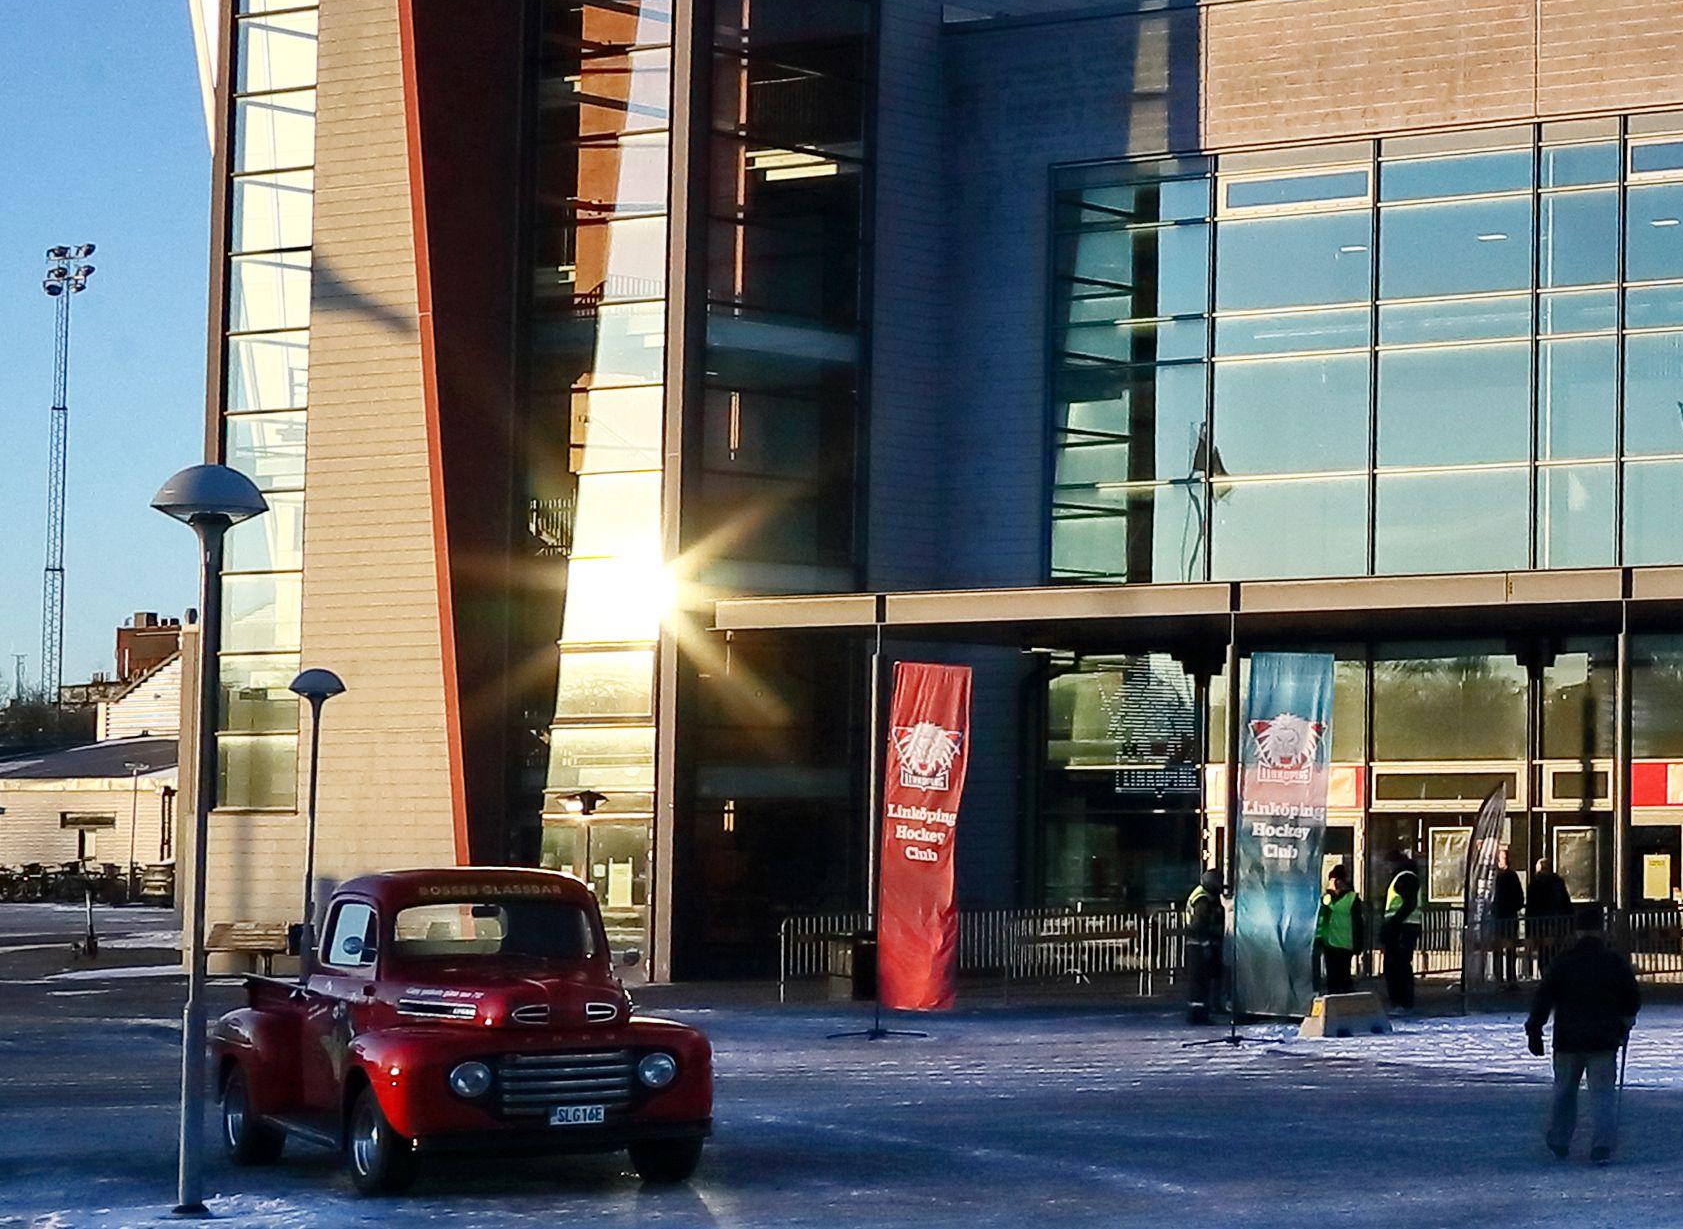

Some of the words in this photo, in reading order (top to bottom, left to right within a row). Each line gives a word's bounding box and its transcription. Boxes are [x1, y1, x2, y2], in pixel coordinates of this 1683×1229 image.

[887, 804, 957, 827] Linköping
[1242, 800, 1325, 821] Linköping
[895, 824, 946, 845] Hockey
[1251, 822, 1311, 841] Hockey
[905, 846, 938, 862] Club
[1262, 843, 1298, 859] Club
